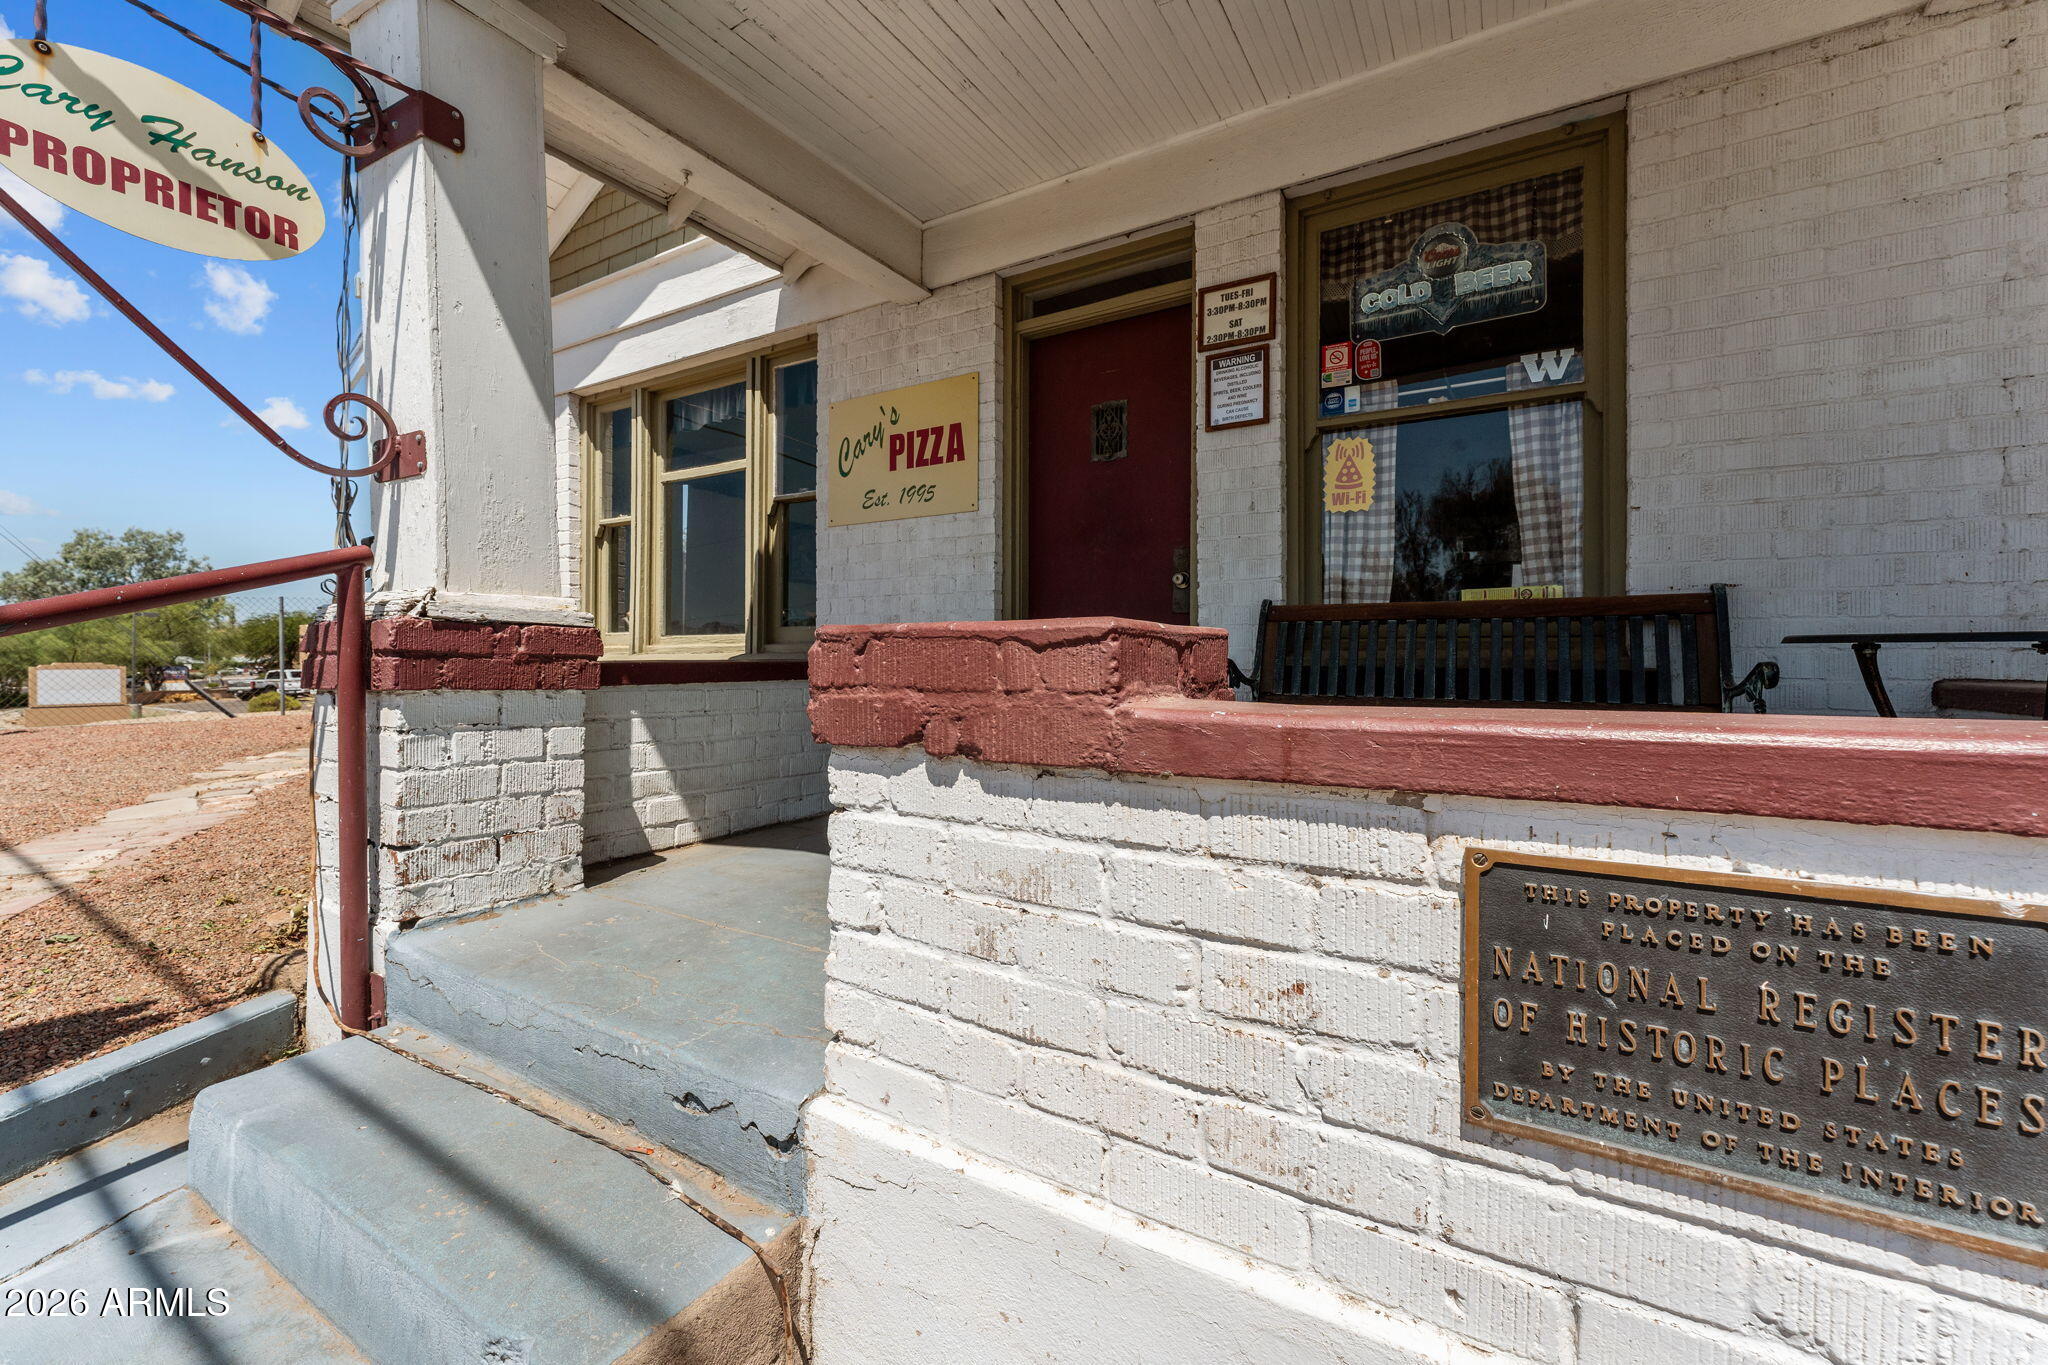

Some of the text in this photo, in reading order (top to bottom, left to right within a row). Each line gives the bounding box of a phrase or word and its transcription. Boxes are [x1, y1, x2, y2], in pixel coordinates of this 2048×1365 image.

[141, 115, 311, 202] Hanson
[0, 118, 299, 251] PROPRIETOR
[1426, 256, 1459, 270] LIGHT
[1220, 287, 1254, 302] TUES-FRI
[1361, 260, 1533, 314] COLD BEER
[1206, 297, 1267, 317] 3:30PM-8:30PM
[1206, 325, 1266, 344] 2:30PM-8:30PM
[1229, 318, 1243, 329] SAT
[1216, 363, 1259, 376] DRINKING ALCOHOLIC
[1218, 353, 1256, 369] WARNING
[1520, 348, 1575, 383] W
[1226, 379, 1247, 387] DISTILLED
[1239, 369, 1261, 378] INCLUDING
[1242, 383, 1262, 391] COOLERS
[1233, 398, 1258, 407] PREGNANCY
[1234, 412, 1254, 420] DEFECTS
[838, 405, 900, 478] Cary's
[889, 422, 966, 472] PIZZA
[862, 484, 937, 510] Est. 1995
[1331, 490, 1367, 506] Wi-Fi
[1524, 882, 1994, 955] THIS PROPERTY HAS BEEN
[1602, 921, 1891, 976] PLACED ON THE
[1493, 945, 2048, 1069] NATIONAL REGISTER
[1493, 998, 2047, 1134] OF HISTORIC PLACES
[1541, 1060, 1966, 1167] BY THE UNITED STATES
[1493, 1081, 2046, 1225] DEPARTMENT OF THE INTERIOR
